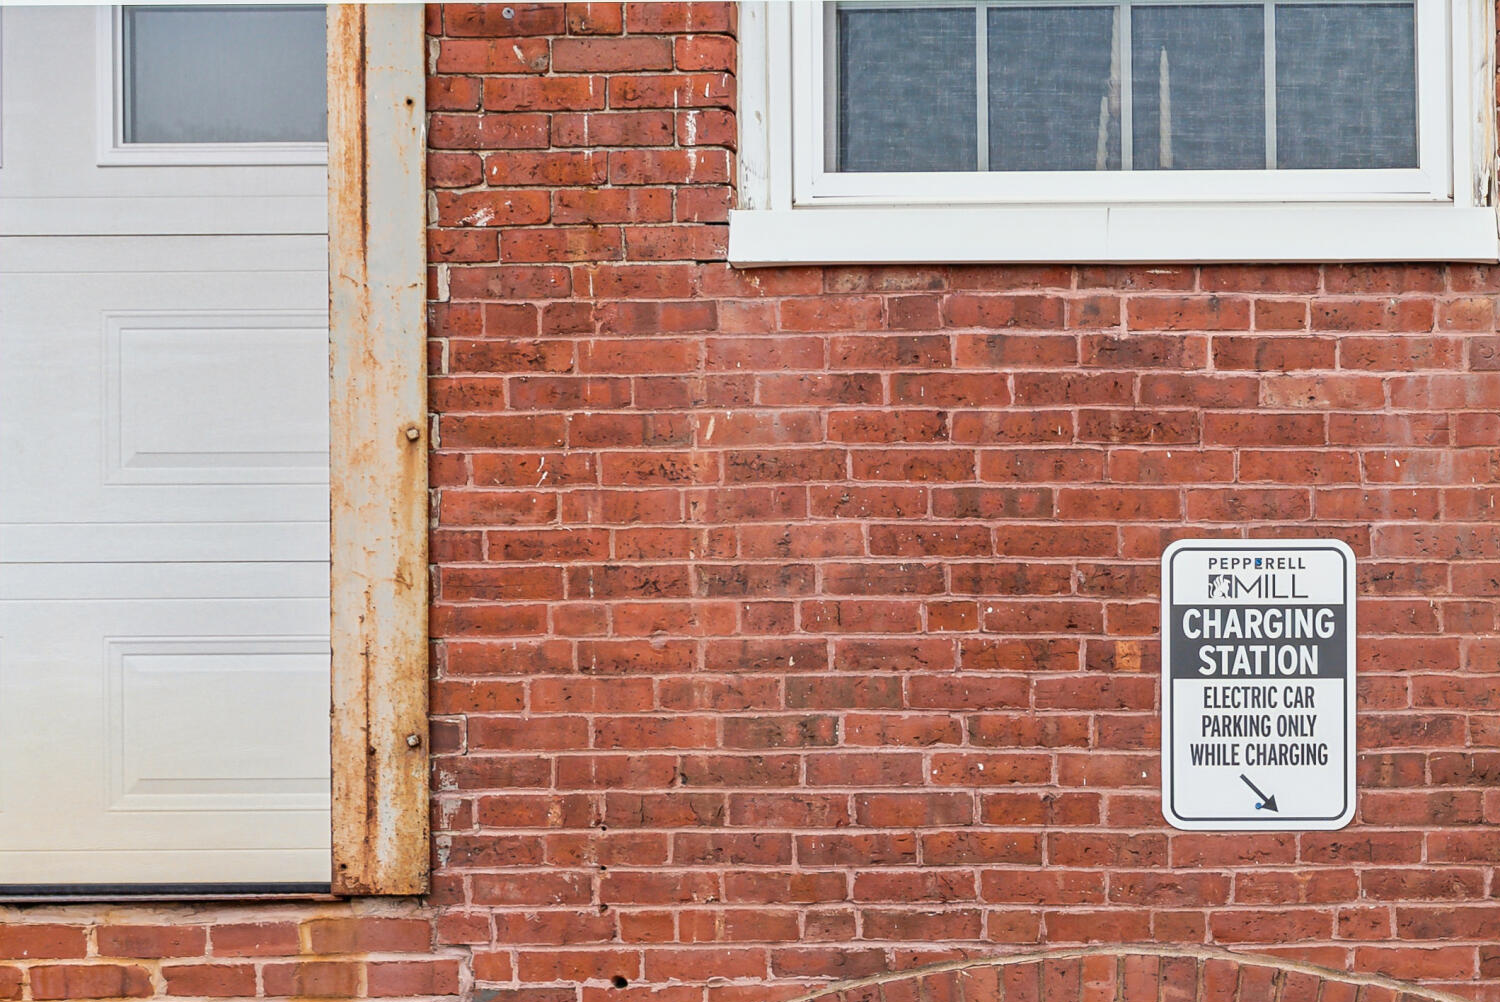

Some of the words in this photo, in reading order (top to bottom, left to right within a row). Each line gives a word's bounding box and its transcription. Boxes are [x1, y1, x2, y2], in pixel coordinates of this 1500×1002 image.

[1234, 574, 1309, 598] MILL
[1182, 608, 1336, 639] CHARGING
[1198, 645, 1319, 675] STATION
[1203, 686, 1278, 709] ELECTRIC
[1283, 686, 1315, 709] CAR
[1201, 715, 1271, 737] PARKING
[1276, 715, 1317, 737] ONLY
[1190, 743, 1240, 766] WHILE
[1245, 743, 1328, 766] CHARGING
